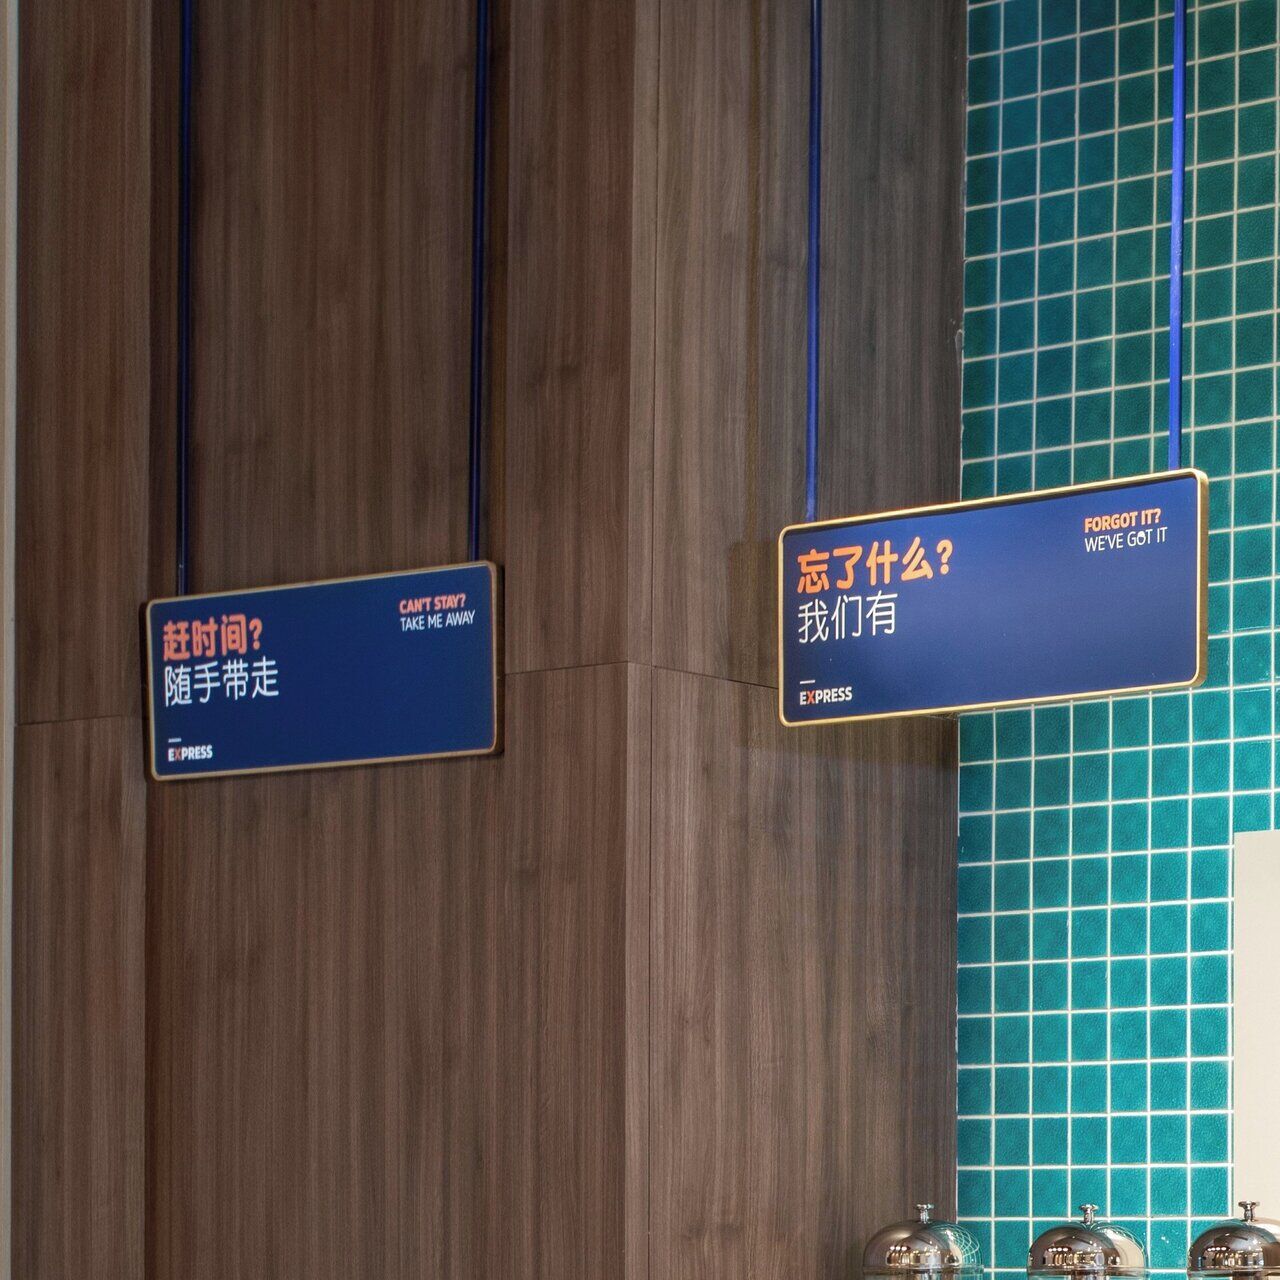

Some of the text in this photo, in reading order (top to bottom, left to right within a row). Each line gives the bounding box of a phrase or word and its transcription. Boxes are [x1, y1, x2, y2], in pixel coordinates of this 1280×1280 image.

[1084, 508, 1161, 533] FORGOT IT?
[1084, 526, 1167, 552] WE'VE GOT IT
[797, 536, 954, 594] 忘了什么?
[399, 593, 466, 614] CAN'T STAY?
[400, 610, 476, 632] TAKE ME AWAY
[798, 590, 898, 644] 我们有
[163, 613, 263, 662] 赶时间?
[165, 656, 279, 707] 随手带走
[799, 686, 853, 706] EXPRESS
[168, 744, 213, 762] EXPRESS
